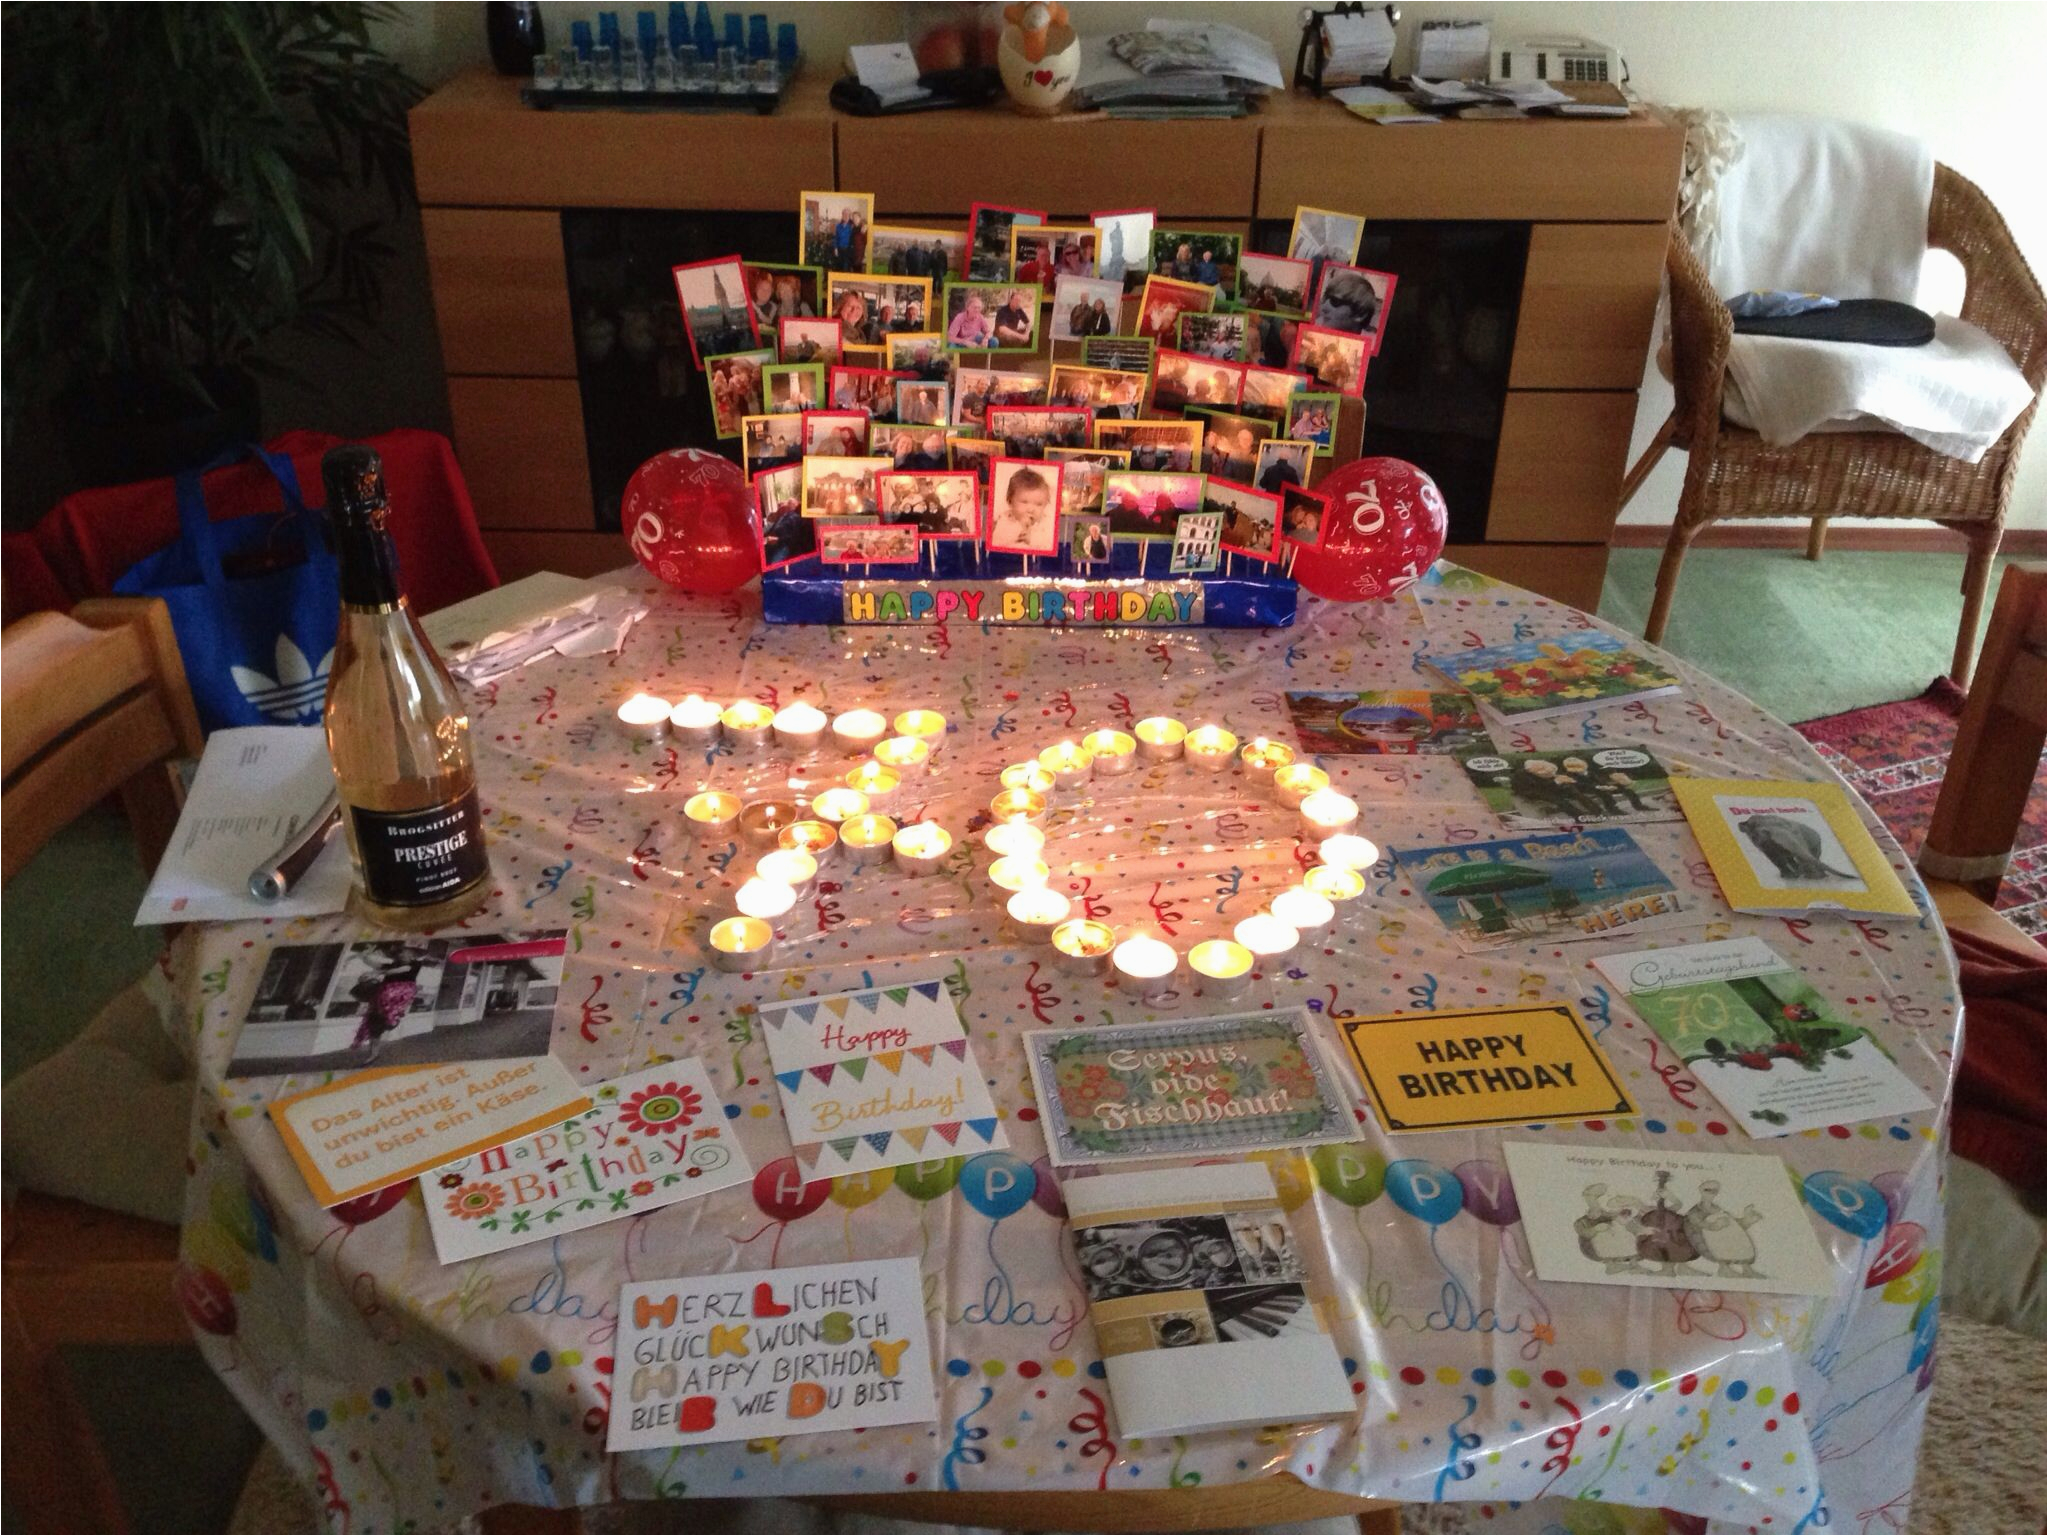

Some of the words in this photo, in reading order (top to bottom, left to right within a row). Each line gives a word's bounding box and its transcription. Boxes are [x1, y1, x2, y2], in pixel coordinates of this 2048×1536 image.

[1344, 478, 1386, 536] 70
[849, 590, 985, 622] HAPPY
[1001, 590, 1198, 623] BIRTHDAY
[387, 810, 465, 837] BROGSITTER
[394, 830, 469, 863] PRESTIGE
[1577, 891, 1684, 935] HERE!
[1660, 992, 1730, 1037] 70
[820, 1023, 913, 1052] Happy
[1107, 1045, 1248, 1072] Servus,
[1415, 1034, 1528, 1064] HAPPY
[311, 1108, 363, 1133] Das
[370, 1079, 430, 1113] Alter
[435, 1065, 471, 1087] ist
[1397, 1062, 1579, 1100] BIRTHDAY
[323, 1093, 461, 1152] unwichtig.
[466, 1061, 538, 1098] Außer
[334, 1145, 370, 1169] du
[375, 1126, 431, 1153] bist
[433, 1110, 474, 1132] ein
[475, 1082, 548, 1115] Käse.
[810, 1076, 965, 1133] Birthday!
[1093, 1088, 1294, 1132] Fischhaut!
[507, 1133, 688, 1207] Birthday
[1566, 1155, 1605, 1167] Happy
[1608, 1156, 1661, 1170] Birthday
[1665, 1160, 1679, 1169] to
[634, 1310, 889, 1366] GLÜCKWUNSCH
[630, 1359, 760, 1404] HAPPY
[771, 1338, 911, 1383] BIRTHDAY
[630, 1395, 717, 1433] BLEIB
[732, 1390, 779, 1417] WIE
[786, 1381, 842, 1419] DU
[853, 1380, 904, 1407] BIST
